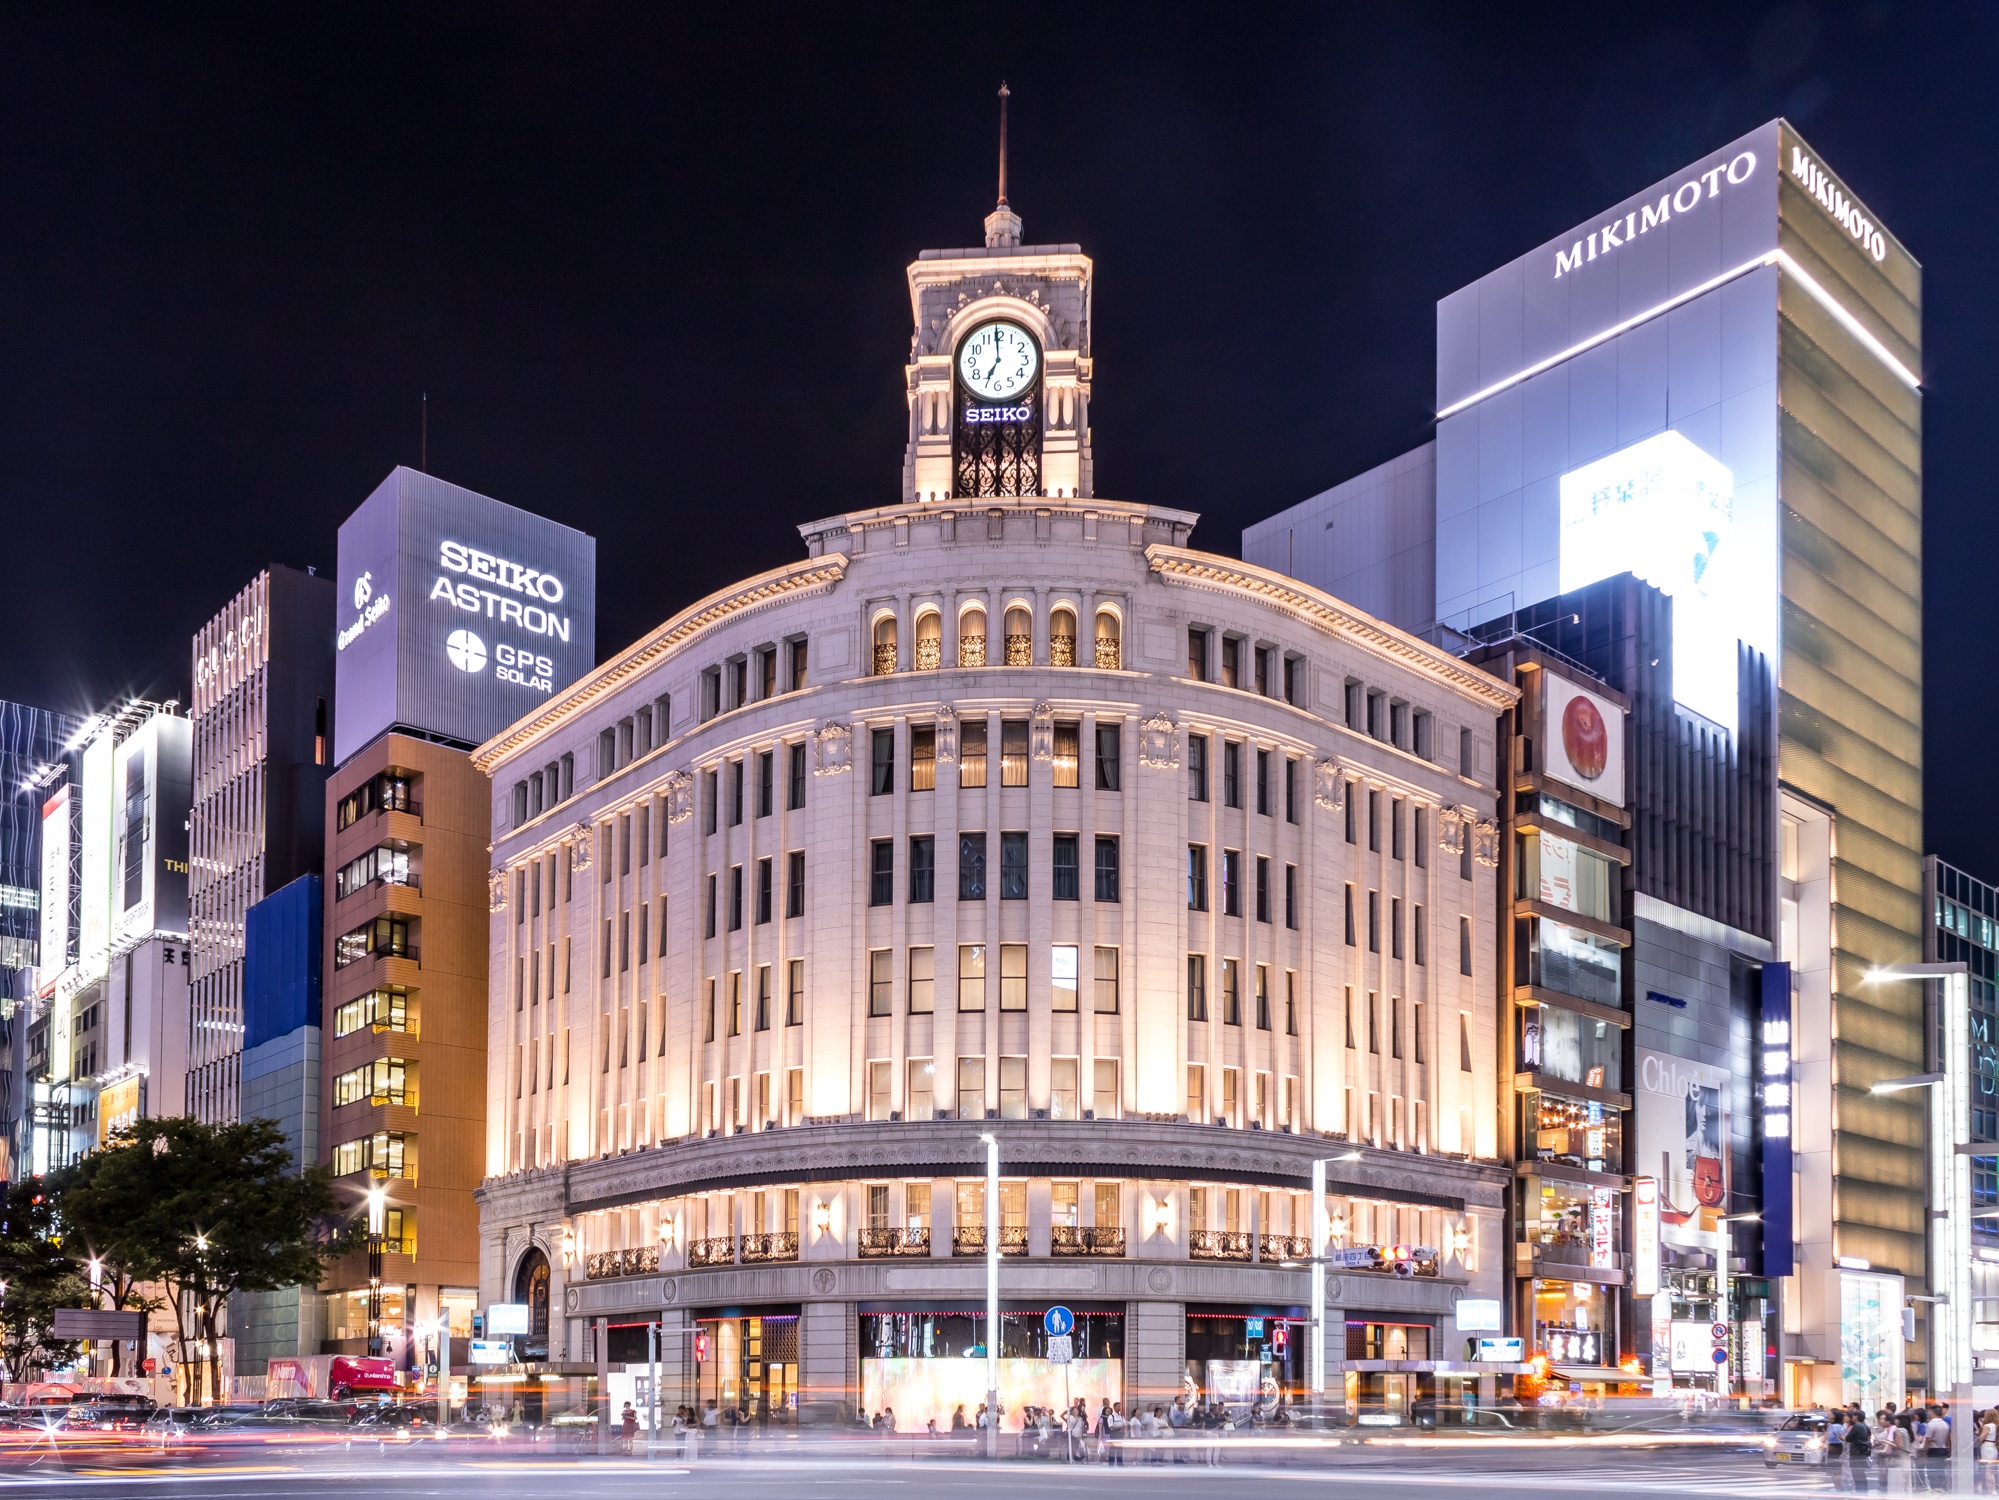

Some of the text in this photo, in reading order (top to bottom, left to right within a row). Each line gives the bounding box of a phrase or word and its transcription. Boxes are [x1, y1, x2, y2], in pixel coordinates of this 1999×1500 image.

[1792, 146, 1886, 262] MIKIMOTO
[1553, 151, 1757, 279] MIKIMOTO
[982, 334, 991, 345] 11
[972, 344, 982, 355] 10
[1017, 342, 1025, 353] 2
[968, 357, 976, 368] 9
[1021, 355, 1029, 366] 3
[972, 368, 981, 380] 8
[1016, 367, 1025, 378] 4
[994, 380, 1002, 391] 6
[1007, 377, 1014, 388] 5
[966, 407, 1030, 422] SEIKO
[440, 540, 564, 604] SEIKO
[429, 576, 570, 642] ASTRON
[337, 593, 391, 651] Grand Seiko
[495, 643, 554, 678] GPS
[495, 665, 553, 693] SOLAR
[1641, 1055, 1702, 1101] Chloé
